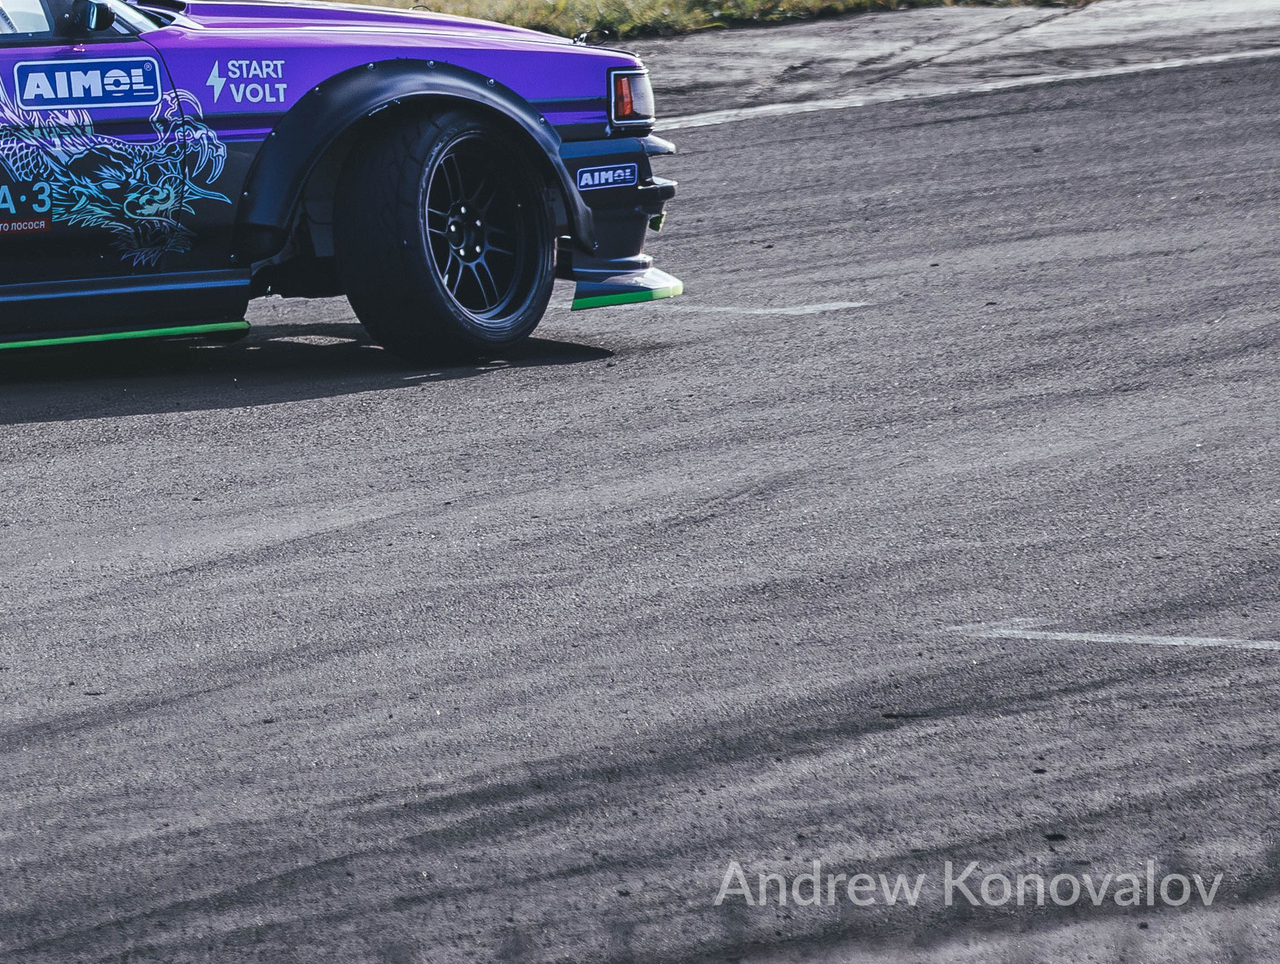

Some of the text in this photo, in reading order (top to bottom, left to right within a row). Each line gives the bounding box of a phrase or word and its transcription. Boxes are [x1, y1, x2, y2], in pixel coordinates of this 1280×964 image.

[227, 60, 286, 80] START
[23, 67, 155, 100] AIMOL
[229, 83, 288, 104] VOLT
[579, 168, 634, 187] AIMOL
[11, 220, 46, 231] ЛОСОСЯ
